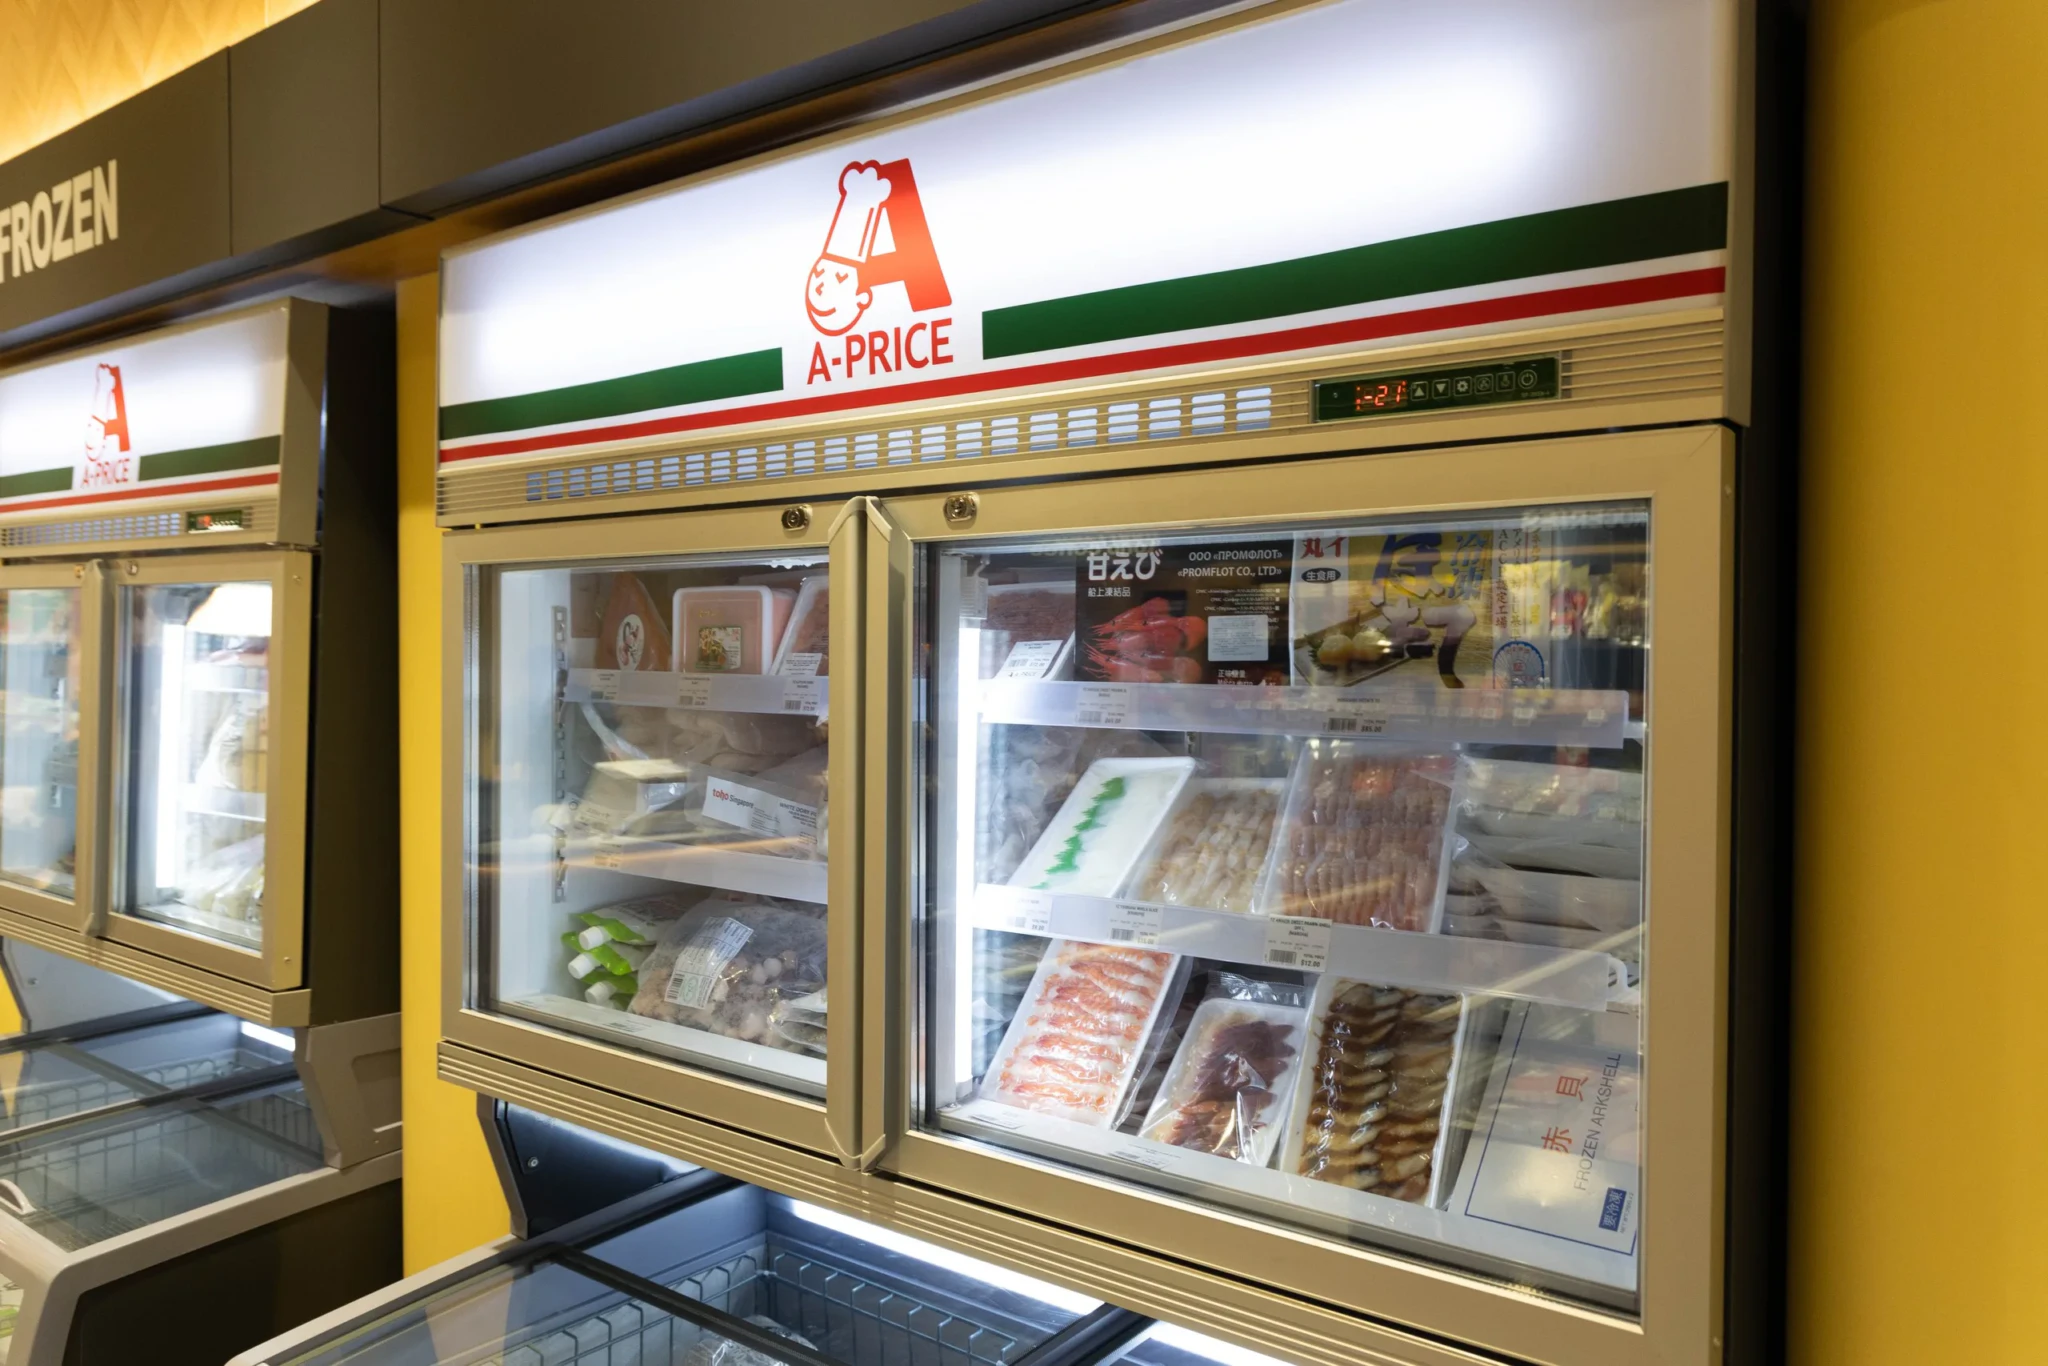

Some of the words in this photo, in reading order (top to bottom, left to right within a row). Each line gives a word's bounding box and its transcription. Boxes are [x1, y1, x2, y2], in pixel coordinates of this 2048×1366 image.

[0, 159, 118, 283] FROZEN
[807, 318, 954, 385] A-PRICE
[81, 458, 130, 488] A-PRICE
[1087, 549, 1163, 581] 甘えび
[1178, 566, 1234, 578] «PROMFLOT
[1237, 567, 1256, 578] CO.,
[1258, 565, 1282, 576] LTD»
[1306, 569, 1337, 583] 生食用
[712, 788, 729, 802] toho
[729, 794, 755, 809] Singapore
[1573, 1129, 1601, 1191] FROZEN
[1592, 1053, 1621, 1126] ARKSHELL
[1603, 1190, 1624, 1228] 要冷凍
